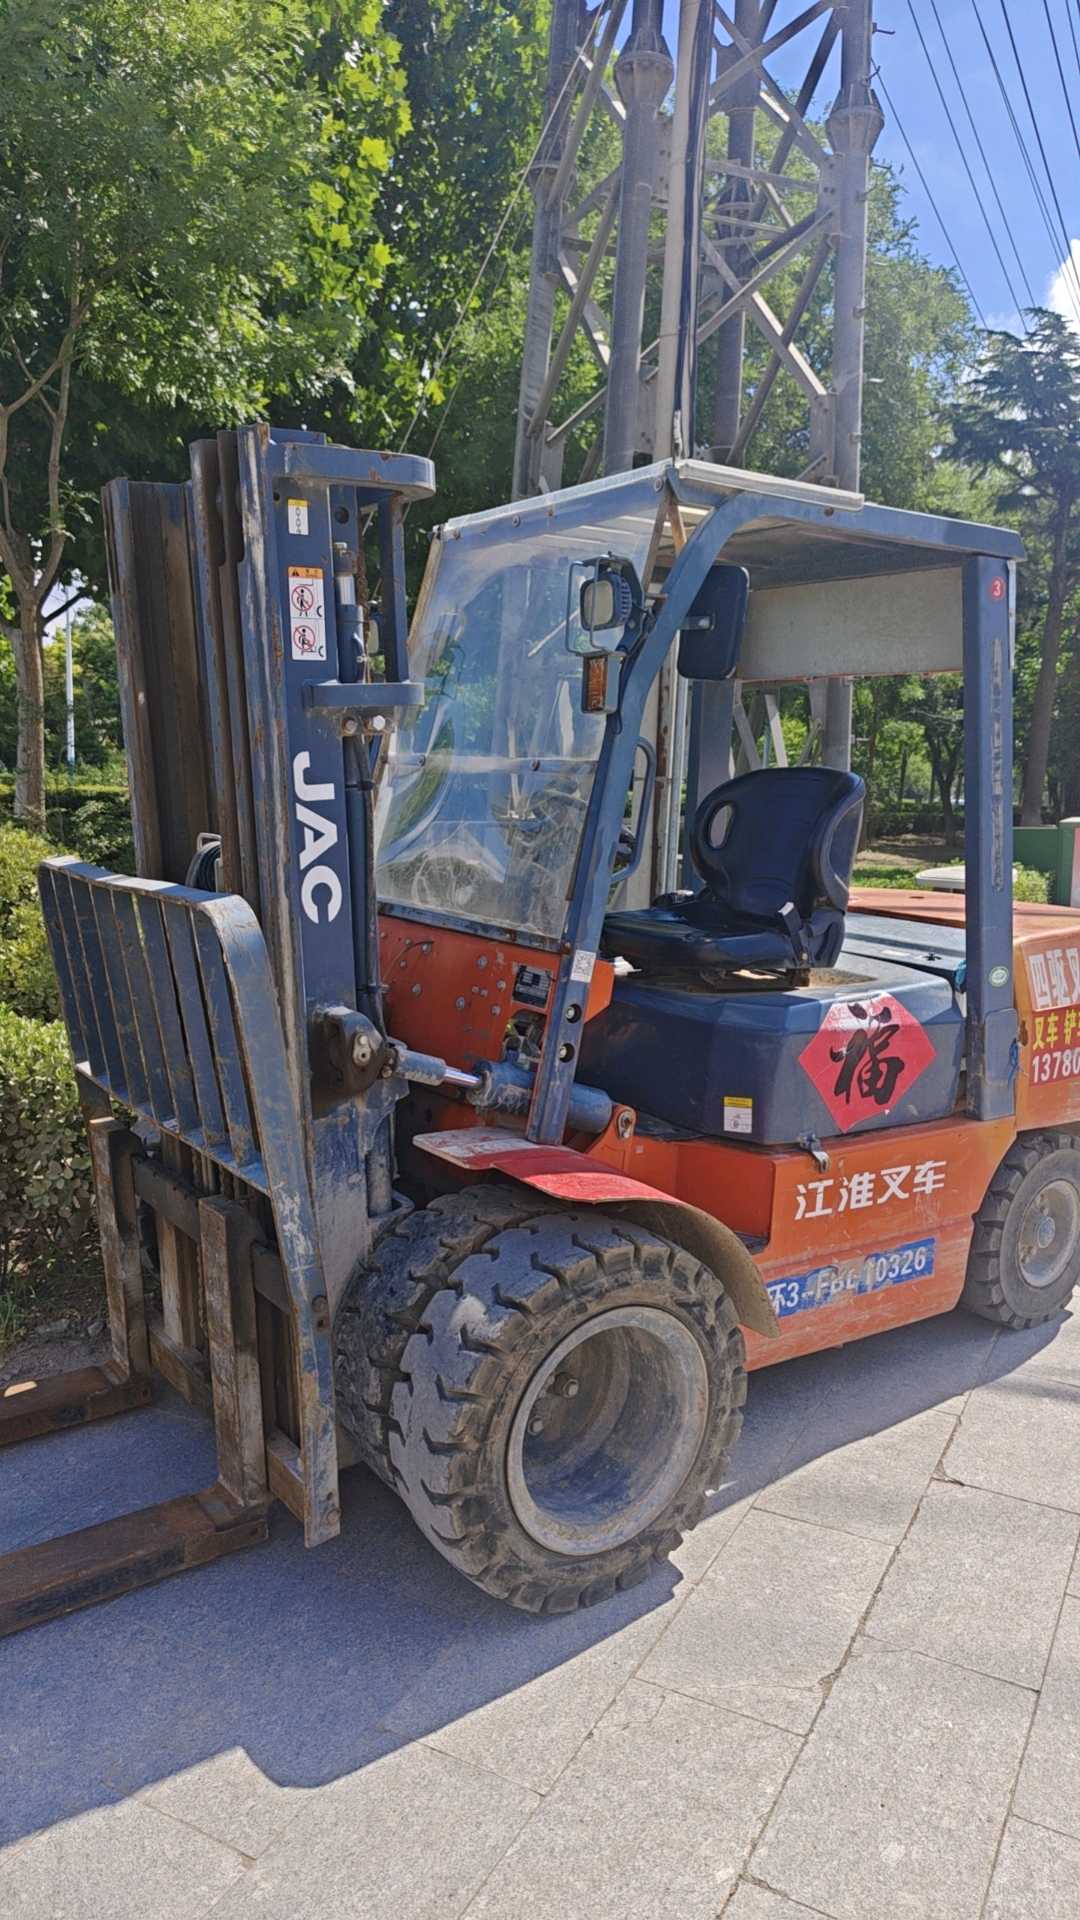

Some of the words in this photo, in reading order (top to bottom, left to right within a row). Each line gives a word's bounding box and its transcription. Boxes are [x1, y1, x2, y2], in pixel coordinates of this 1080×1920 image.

[992, 579, 1001, 597] 3
[292, 751, 343, 924] JAC
[829, 1001, 905, 1105] 福
[1033, 1013, 1059, 1050] 叉车
[794, 1160, 947, 1221] 江淮叉车
